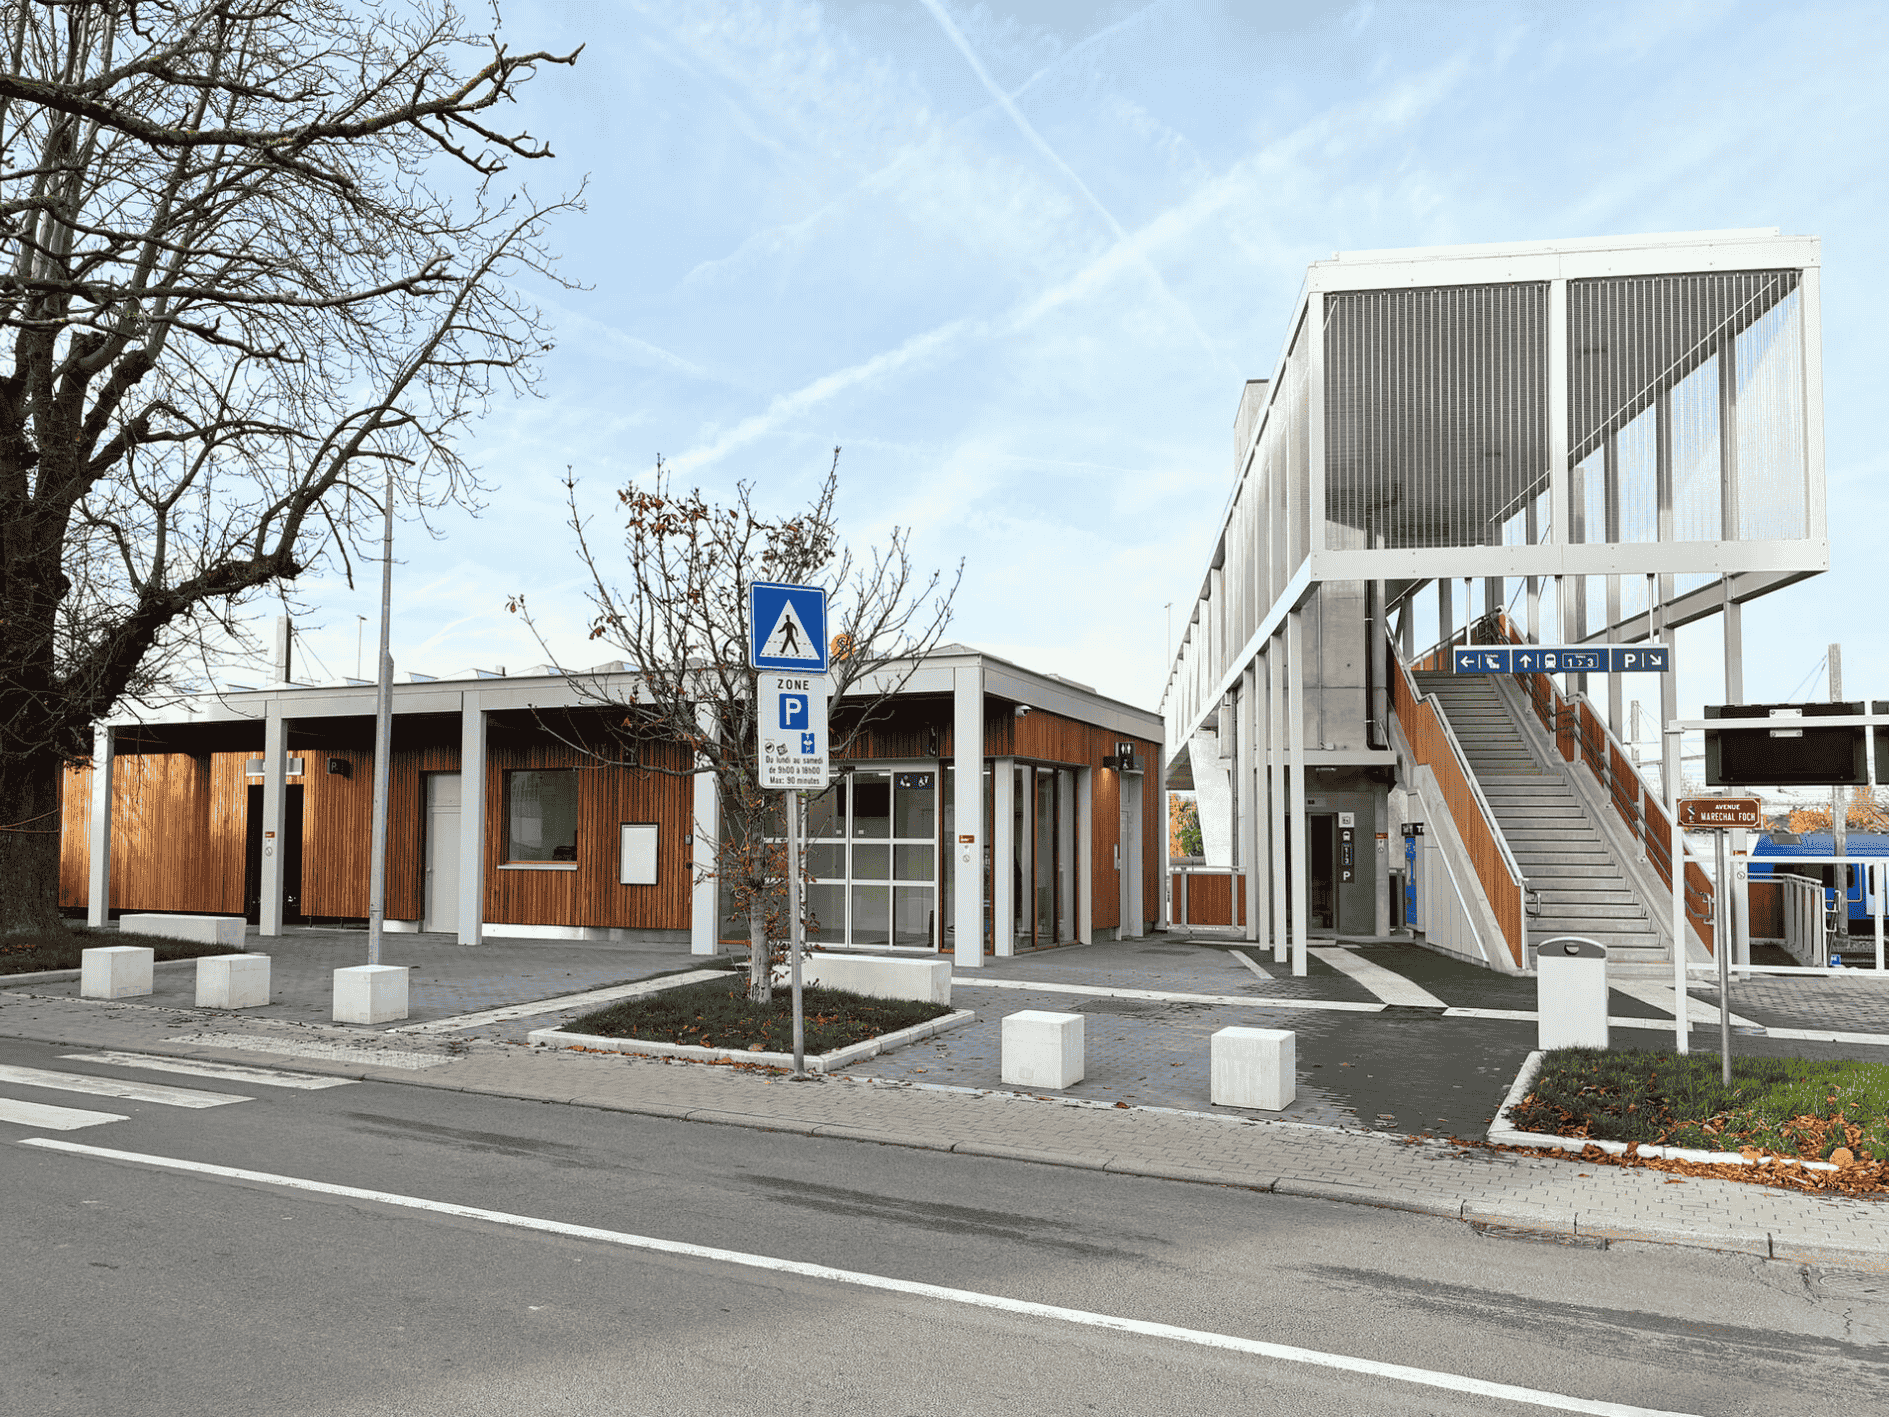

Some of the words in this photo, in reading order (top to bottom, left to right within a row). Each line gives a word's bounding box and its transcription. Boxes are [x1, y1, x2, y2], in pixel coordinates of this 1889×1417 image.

[1568, 658, 1573, 667] 1
[1587, 658, 1594, 668] 3
[1624, 653, 1636, 667] P
[777, 678, 810, 691] ZONE
[785, 697, 802, 726] P
[765, 755, 774, 764] Du
[776, 755, 791, 764] lundi
[802, 756, 823, 765] samedi
[768, 766, 776, 774] de
[777, 766, 795, 774] 9h00
[786, 776, 795, 784] 90
[796, 777, 820, 785] minutes
[1700, 812, 1736, 822] MARECHAL
[1738, 812, 1756, 822] FOCH
[1342, 870, 1351, 881] P
